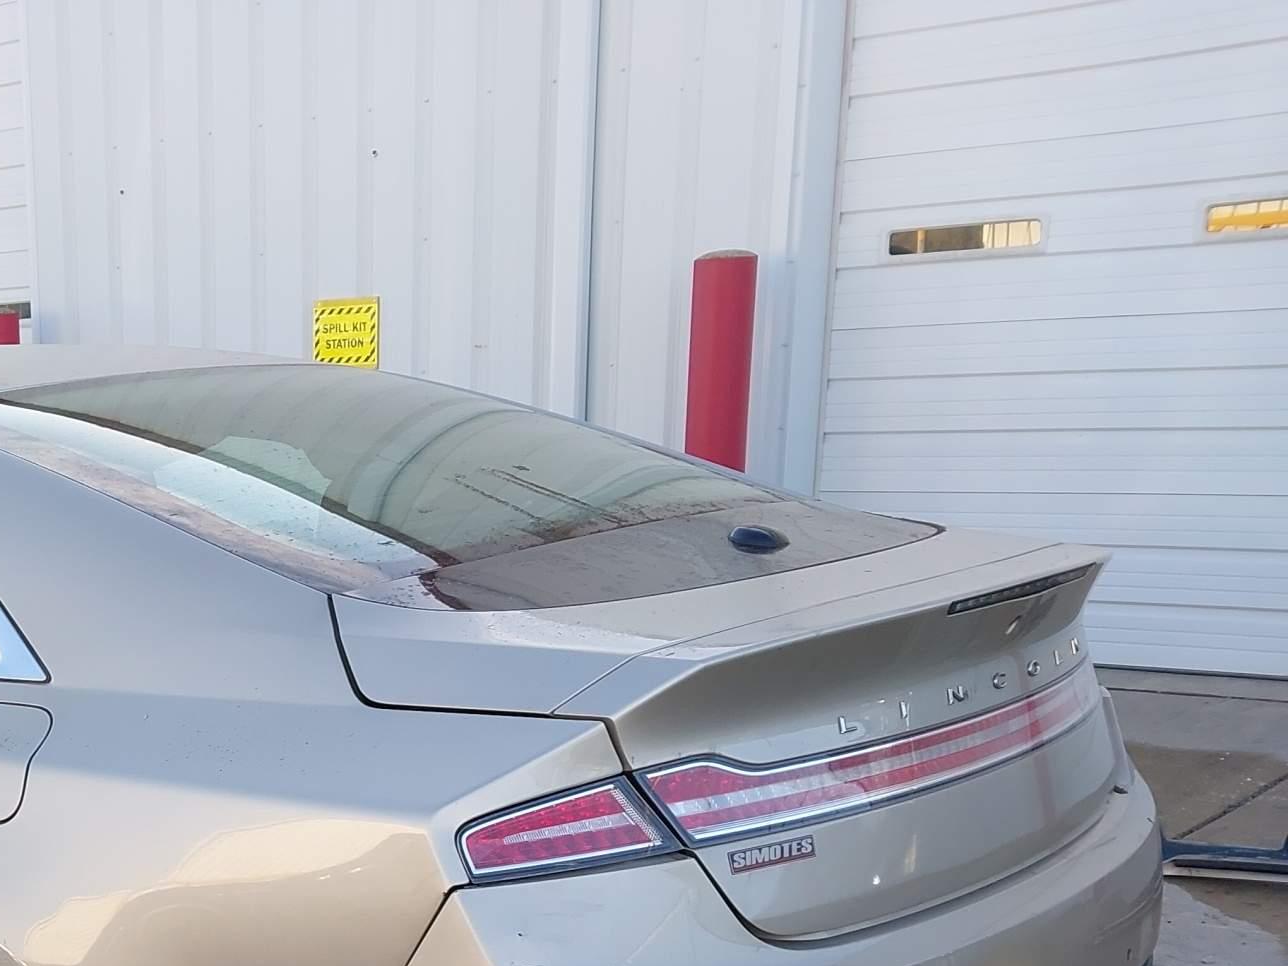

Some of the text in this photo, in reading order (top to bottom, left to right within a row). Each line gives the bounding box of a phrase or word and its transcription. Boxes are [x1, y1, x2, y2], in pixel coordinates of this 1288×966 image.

[322, 321, 367, 334] SPILL KIT
[325, 337, 364, 350] STATION
[837, 636, 1081, 736] LINCOLN
[732, 837, 813, 869] SIMOTES
